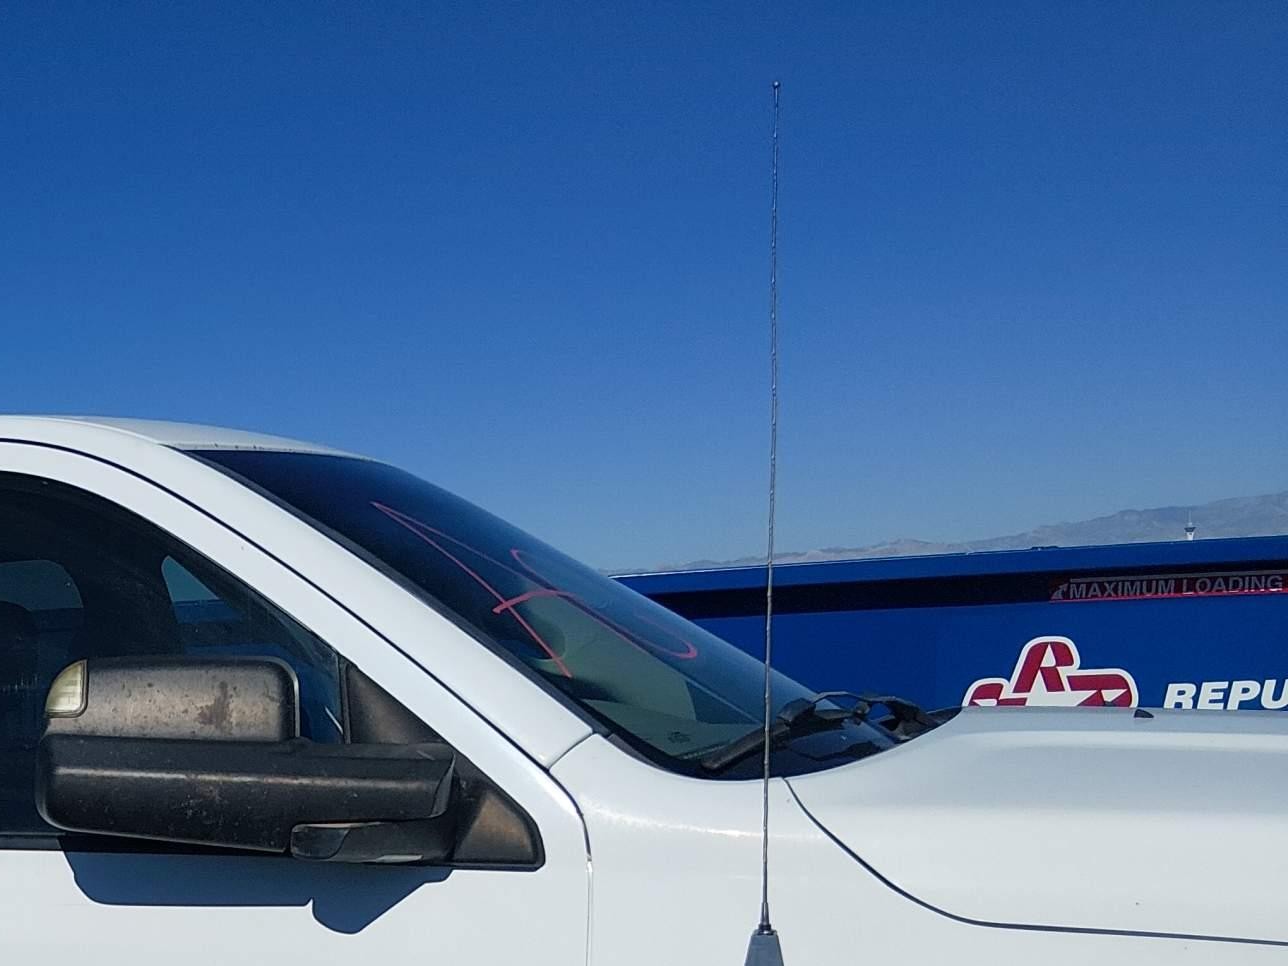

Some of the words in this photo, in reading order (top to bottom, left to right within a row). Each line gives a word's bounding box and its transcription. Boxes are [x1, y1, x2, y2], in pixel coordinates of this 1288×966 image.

[1069, 579, 1175, 599] MAXIMUM
[1182, 575, 1283, 595] LOADING
[1164, 679, 1288, 709] REPU
